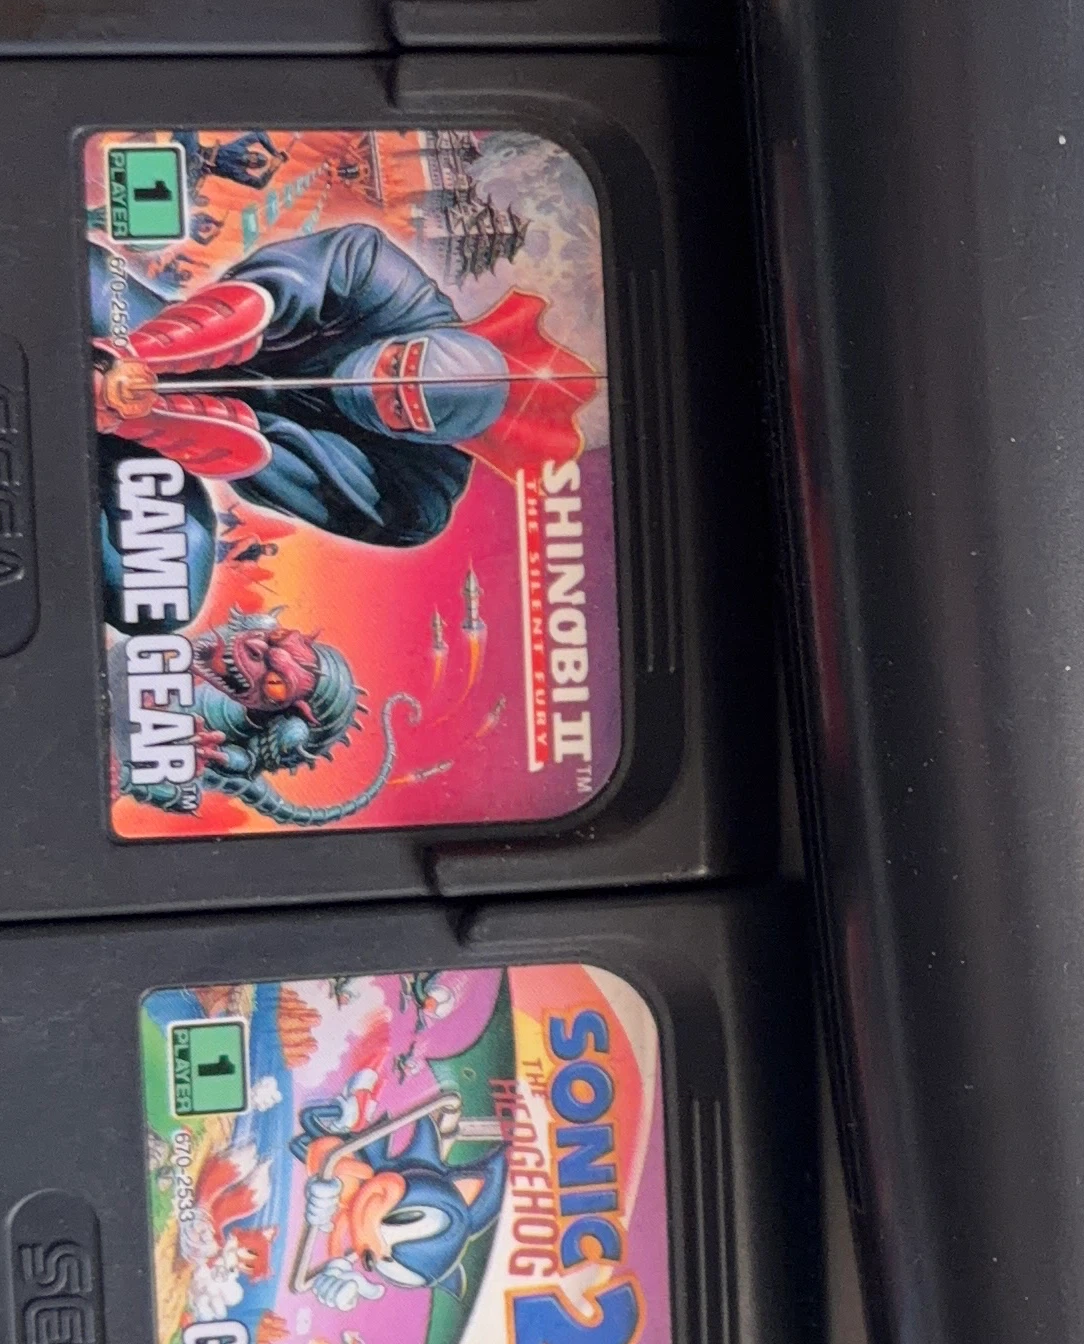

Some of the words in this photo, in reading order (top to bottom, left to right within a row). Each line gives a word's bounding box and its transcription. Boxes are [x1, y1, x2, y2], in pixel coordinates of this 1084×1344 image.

[110, 151, 128, 238] PLAYER
[134, 179, 172, 202] 1
[117, 457, 190, 625] GAME
[525, 479, 539, 533] THE
[529, 550, 545, 655] SILENT
[542, 460, 590, 702] SHINOBI
[125, 633, 198, 785] GEAR
[534, 671, 548, 746] FURY
[553, 711, 592, 763] II
[174, 1029, 192, 1114] PLAYER
[198, 1054, 236, 1077] 1
[521, 1055, 550, 1102] THE
[174, 1132, 197, 1224] 670-2533
[488, 1077, 560, 1278] HEDGEHOG
[546, 1007, 624, 1272] SONIC
